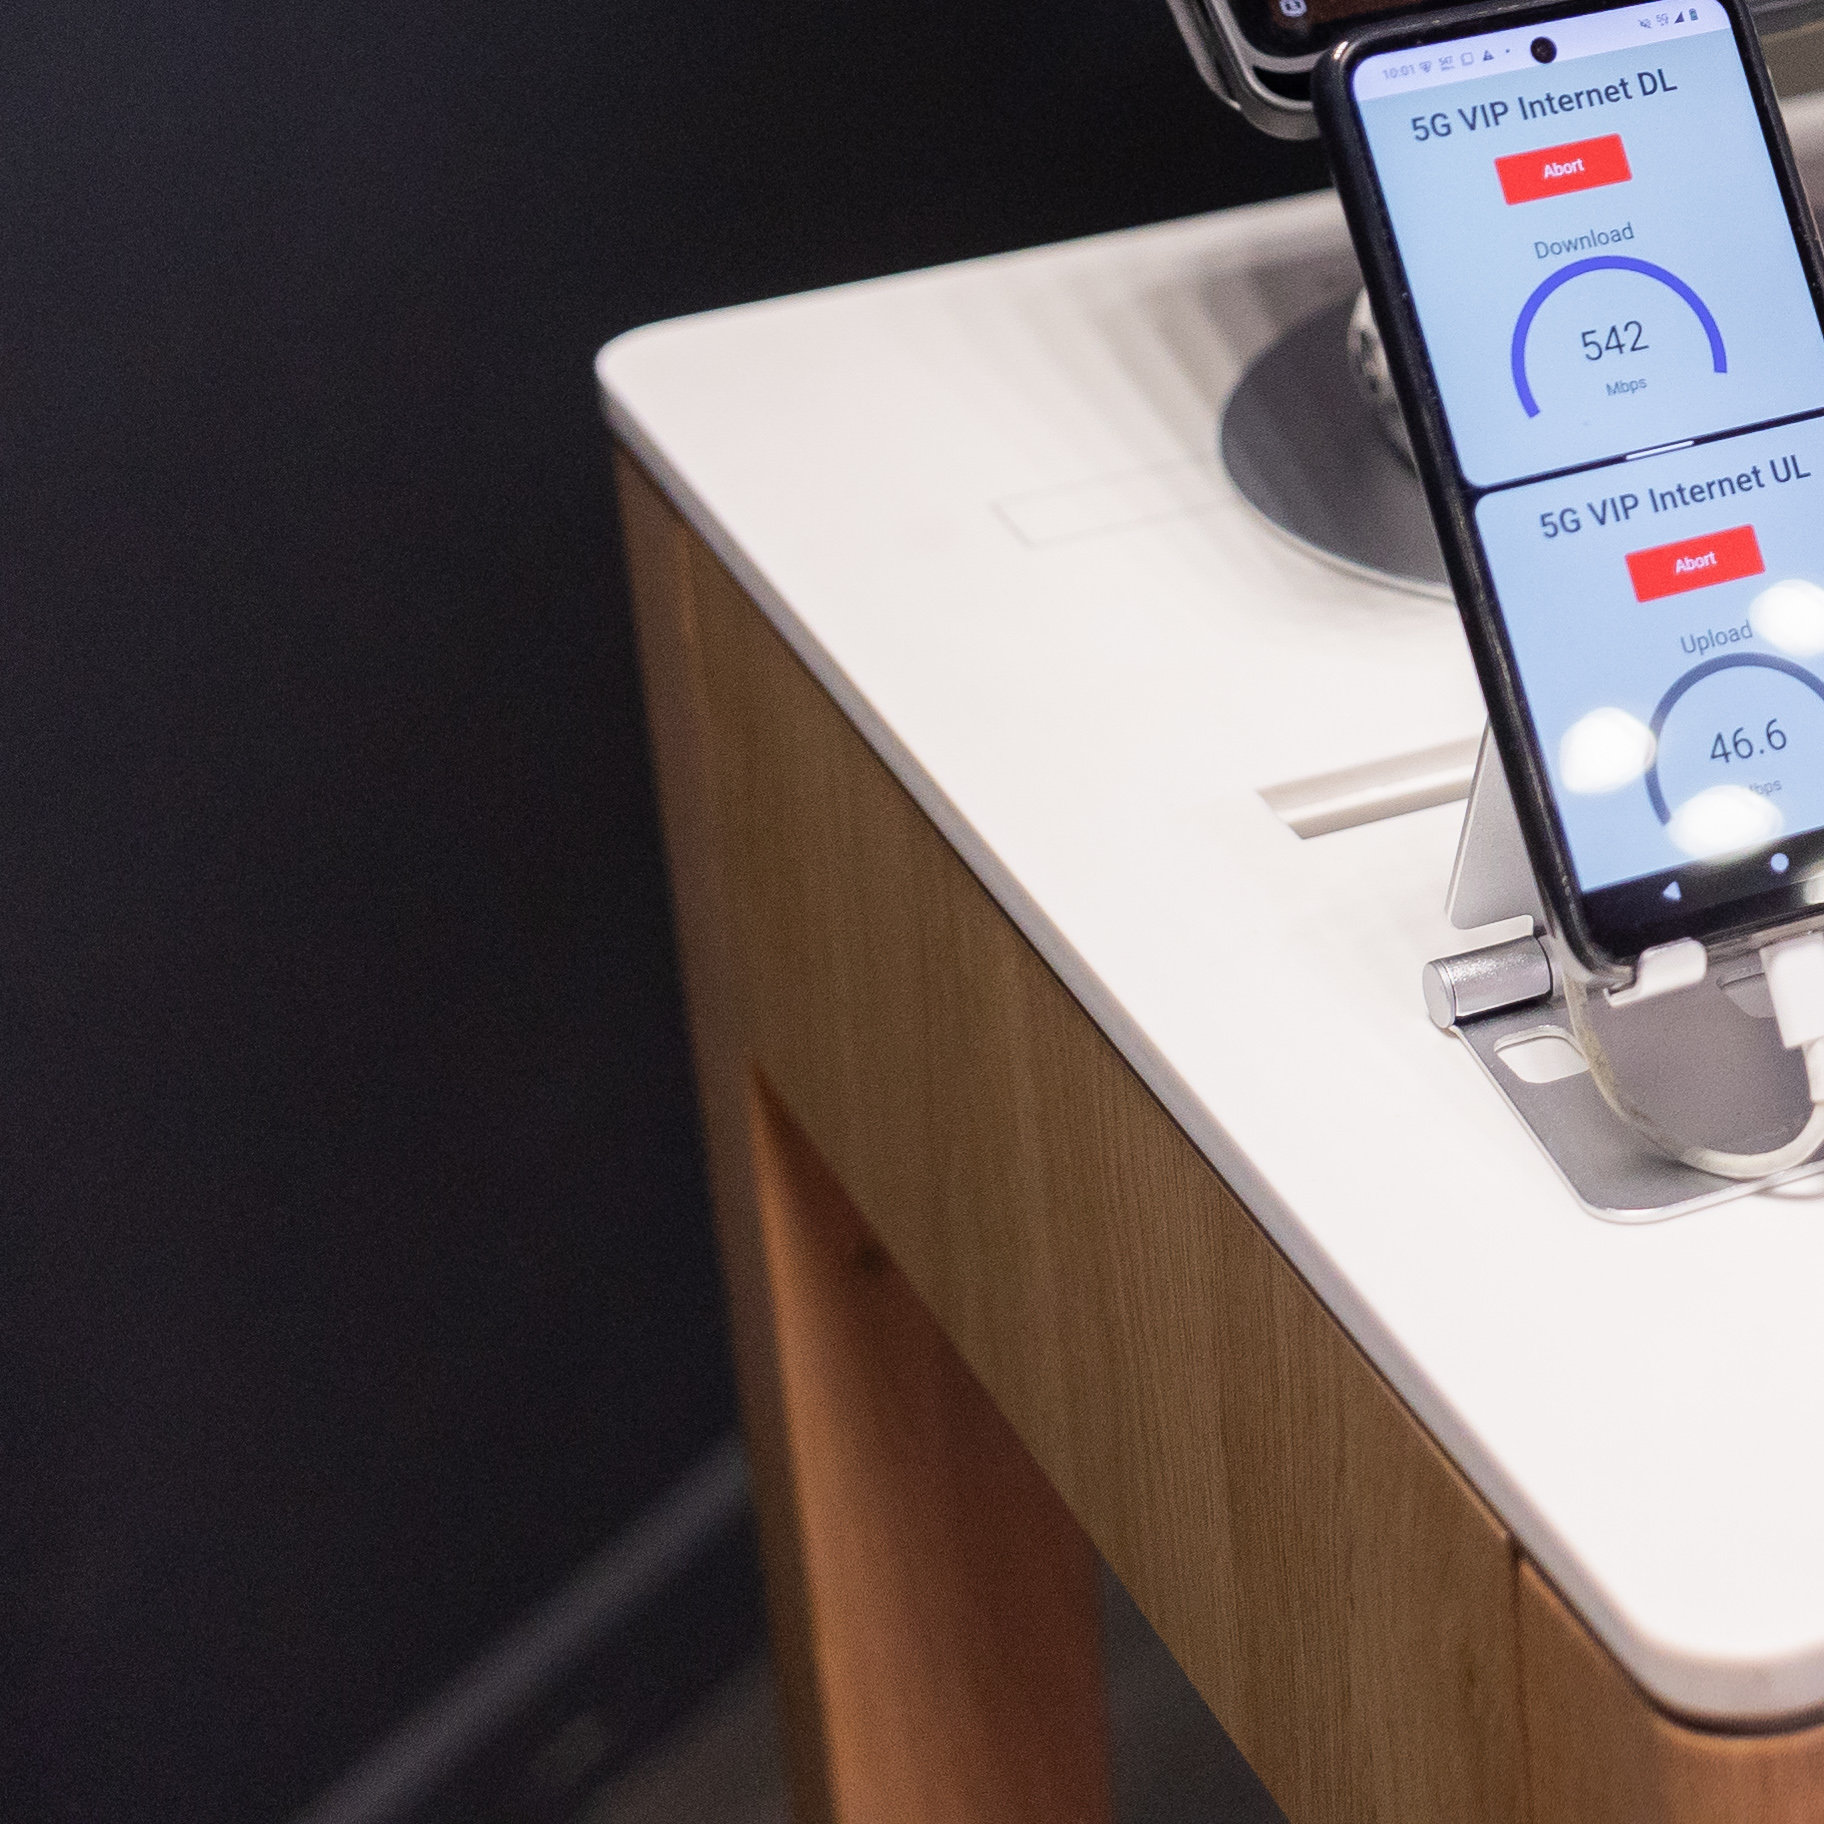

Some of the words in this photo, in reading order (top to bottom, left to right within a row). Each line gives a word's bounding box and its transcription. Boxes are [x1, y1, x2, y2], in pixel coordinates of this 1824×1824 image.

[1410, 111, 1451, 141] 5G
[1458, 100, 1509, 131] VIP
[1517, 76, 1632, 121] Internet
[1638, 65, 1676, 95] DL
[1542, 155, 1584, 178] Abort
[1533, 221, 1635, 259] Download
[1580, 319, 1649, 361] 542
[1605, 374, 1646, 396] Mbps
[1538, 507, 1581, 537] 5G
[1587, 494, 1639, 528] VIP
[1648, 469, 1765, 514] Internet
[1768, 453, 1810, 486] UL
[1673, 550, 1716, 574] Abort
[1679, 619, 1752, 656] Upload
[1708, 717, 1788, 766] 46.6
[1748, 779, 1781, 796] bps
